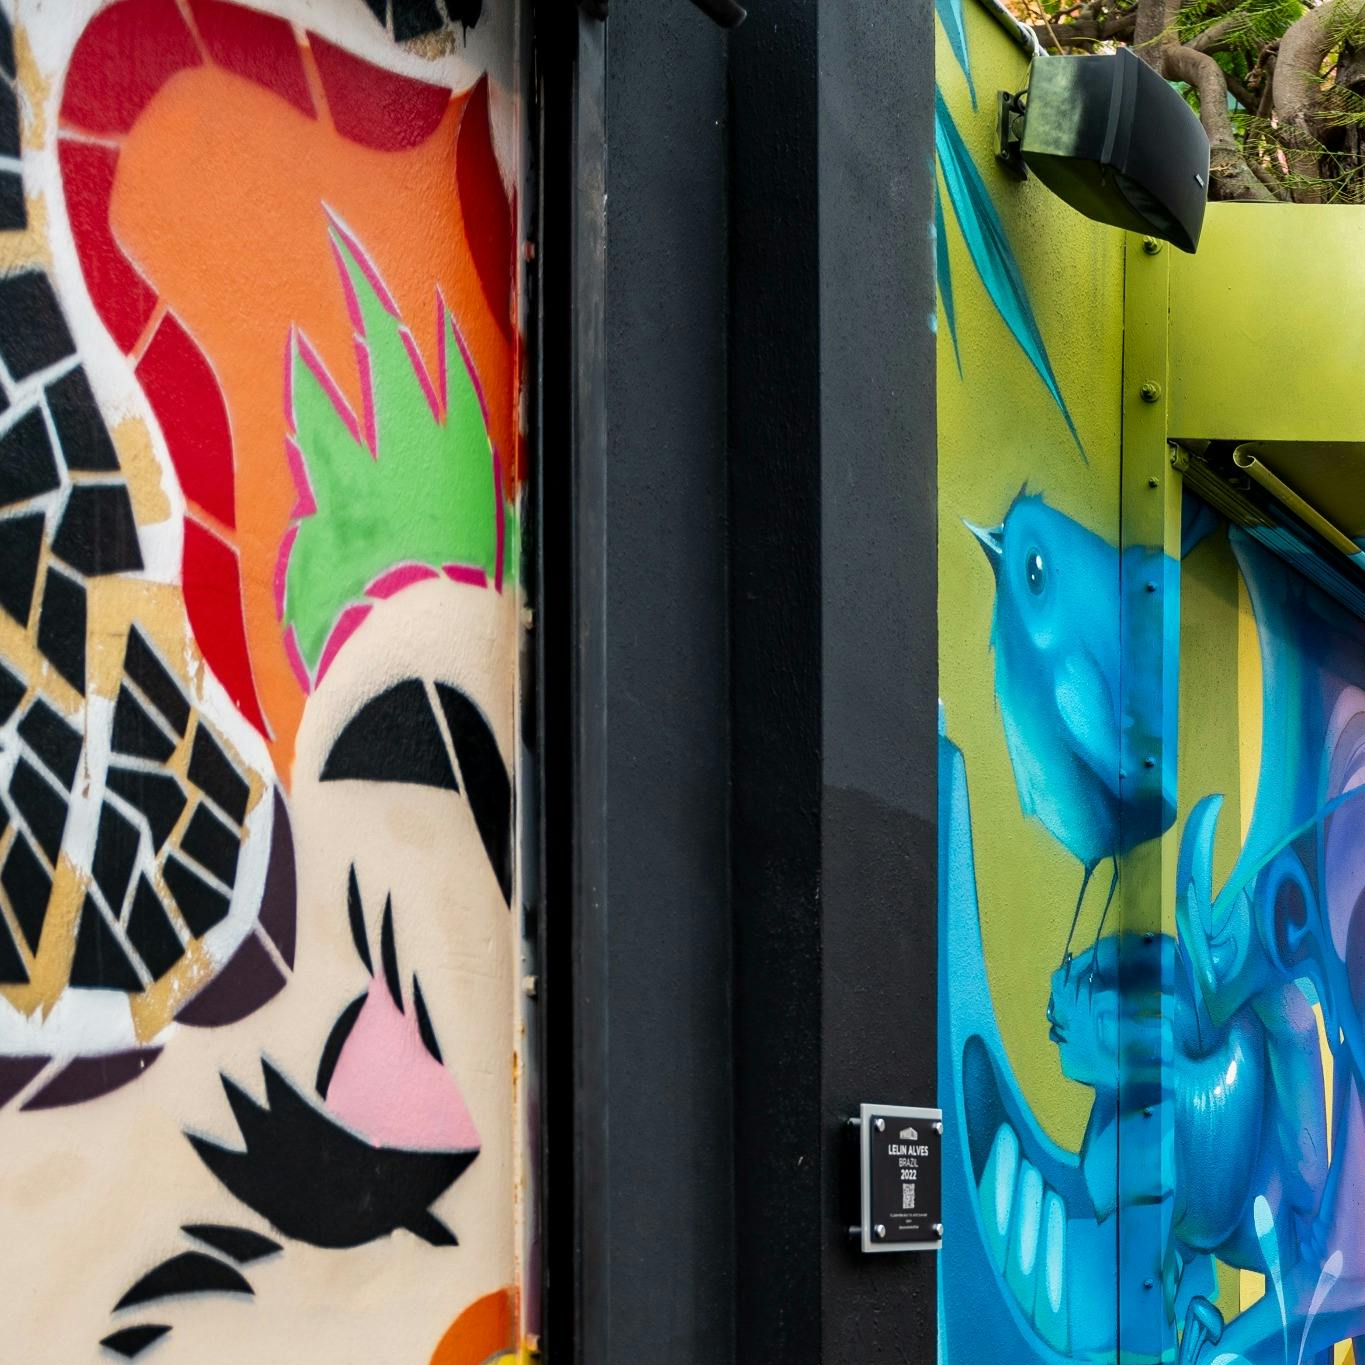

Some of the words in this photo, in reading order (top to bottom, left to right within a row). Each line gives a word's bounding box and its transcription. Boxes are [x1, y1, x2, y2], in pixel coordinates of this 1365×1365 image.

[888, 1144, 907, 1155] LELIN
[908, 1145, 929, 1156] ALVES
[898, 1158, 919, 1168] BRAZIL
[900, 1169, 917, 1180] 2022
